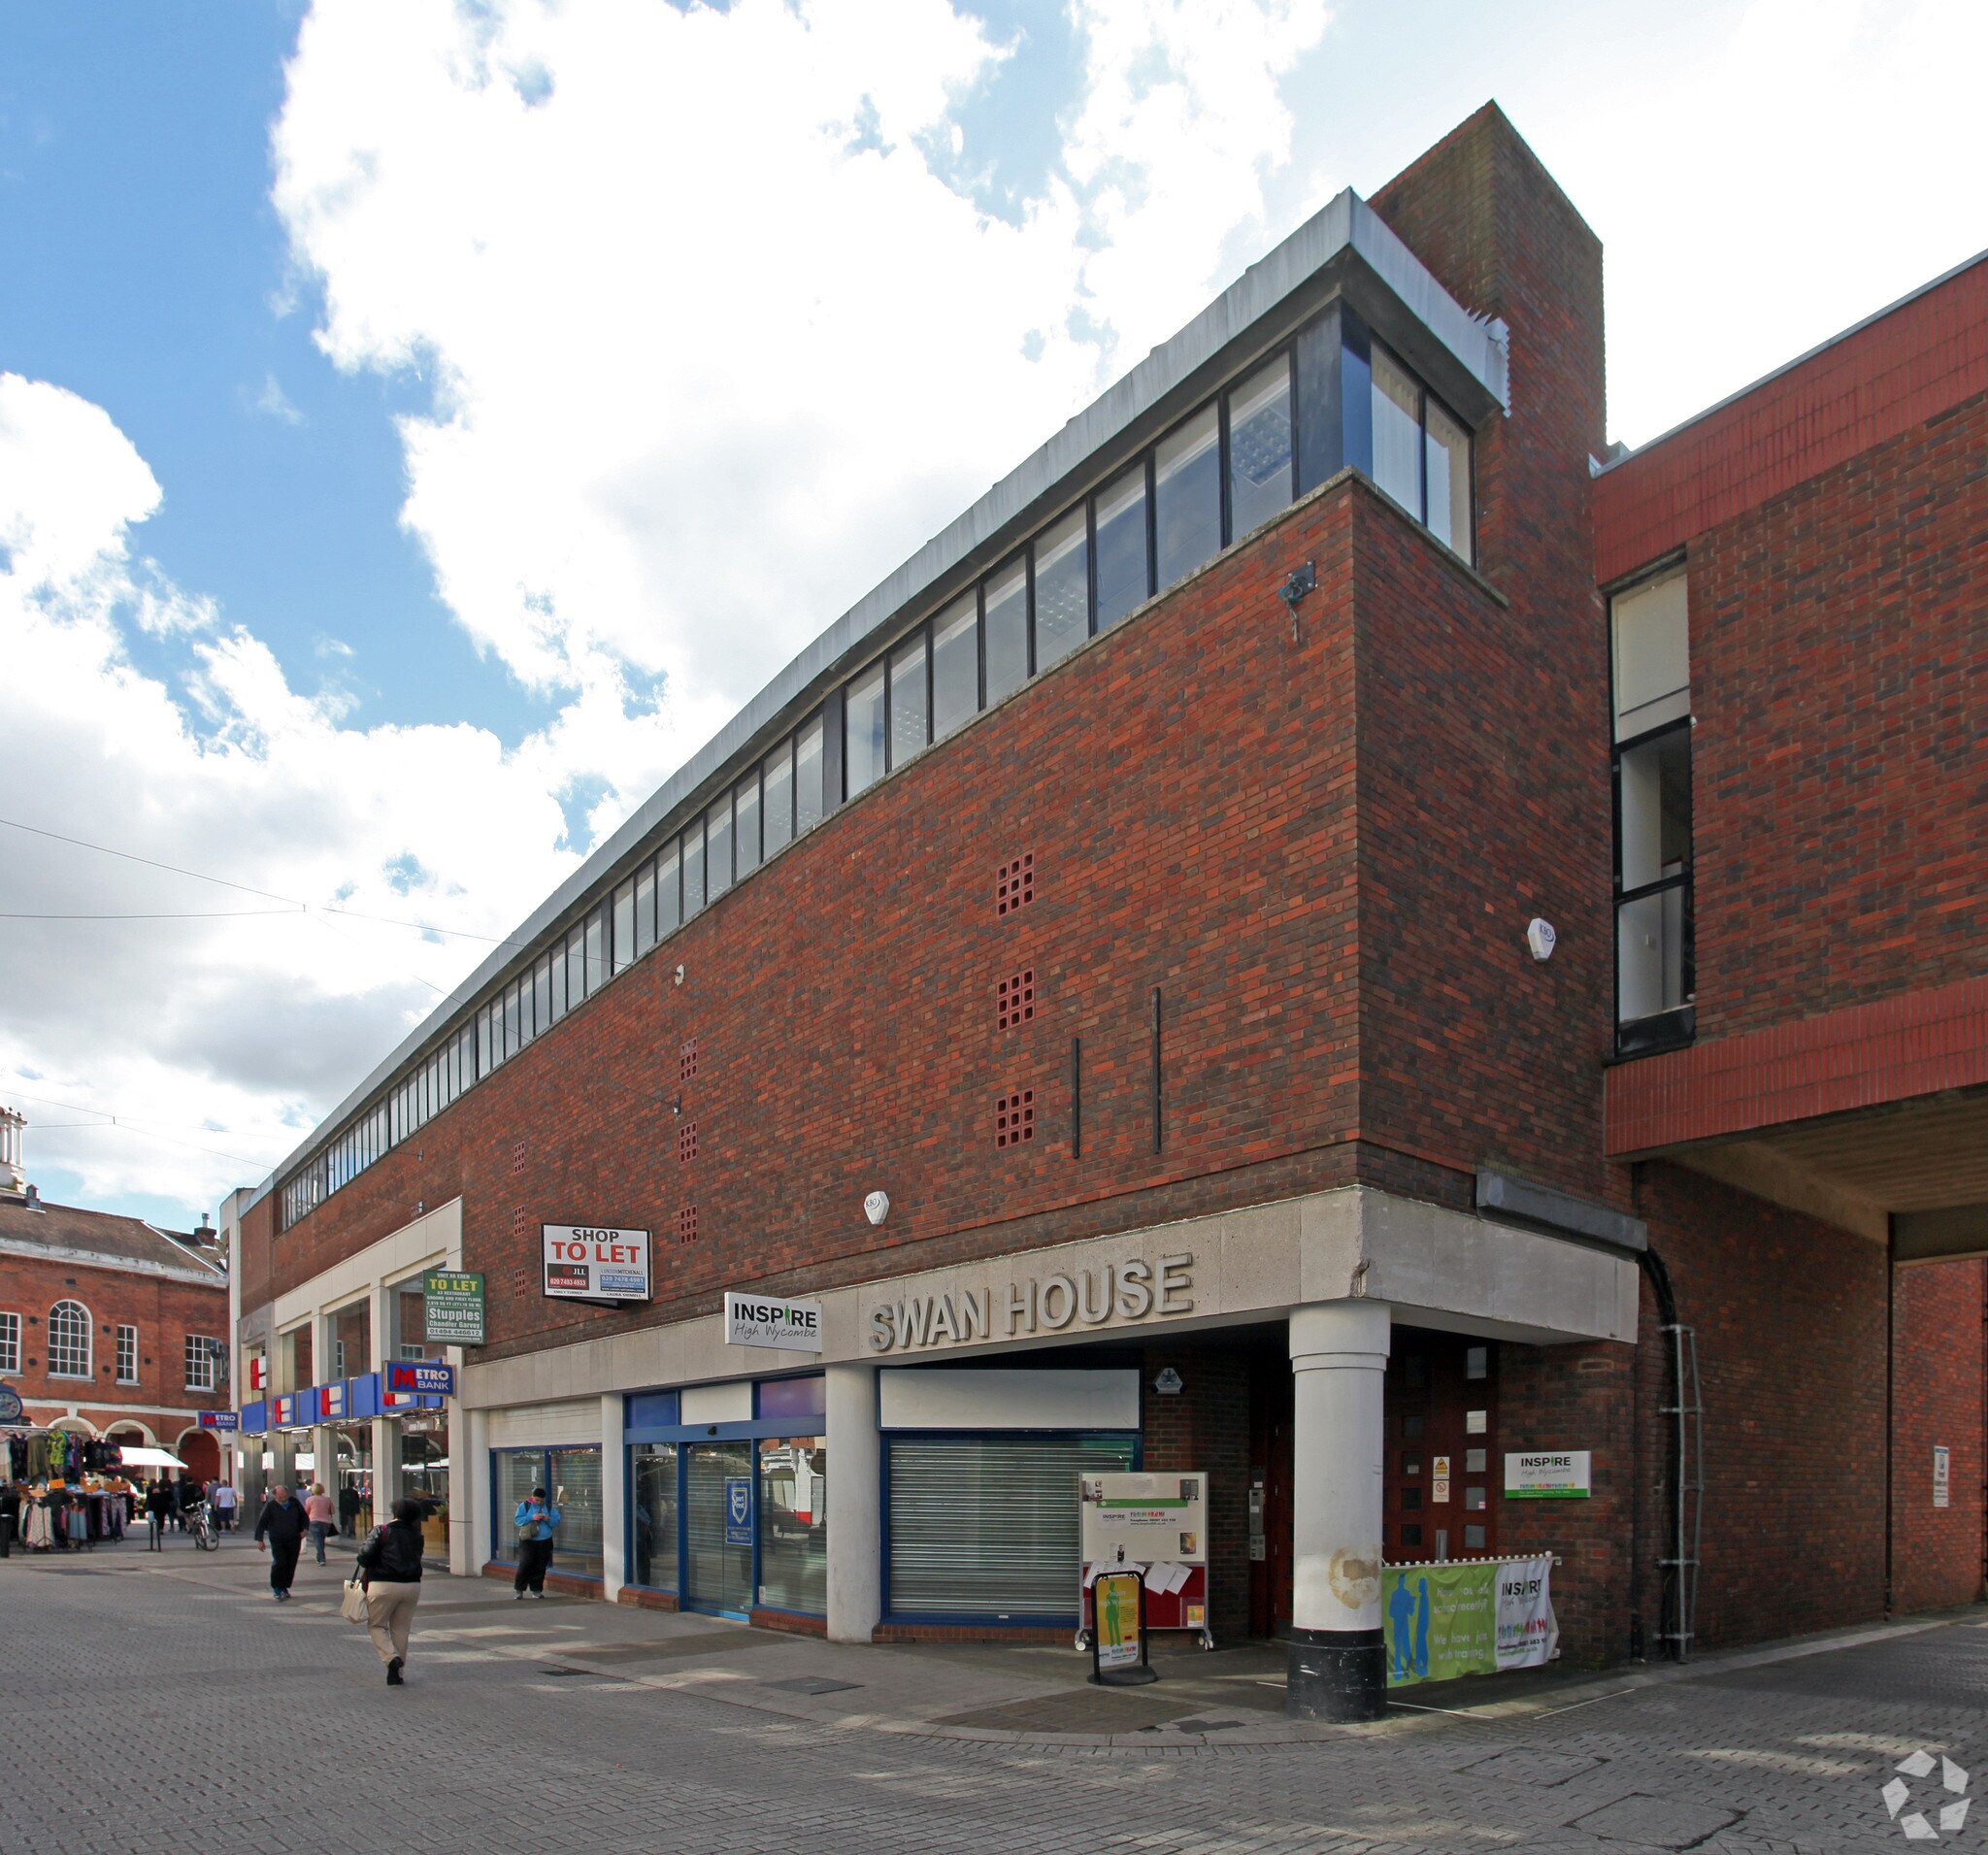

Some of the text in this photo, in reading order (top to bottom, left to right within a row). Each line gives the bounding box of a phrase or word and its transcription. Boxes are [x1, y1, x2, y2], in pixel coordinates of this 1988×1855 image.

[572, 1229, 619, 1242] SHOP
[551, 1242, 641, 1264] TO LET
[429, 1278, 478, 1291] TO LET
[868, 1252, 1193, 1351] SWAN HOUSE
[429, 1308, 480, 1321] Stupples
[734, 1303, 817, 1329] INSPIRE
[735, 1323, 816, 1342] High Wycombe
[392, 1367, 449, 1388] METRO
[417, 1380, 449, 1390] BANK
[202, 1414, 236, 1425] METRO
[1521, 1456, 1571, 1467] INSPIRE
